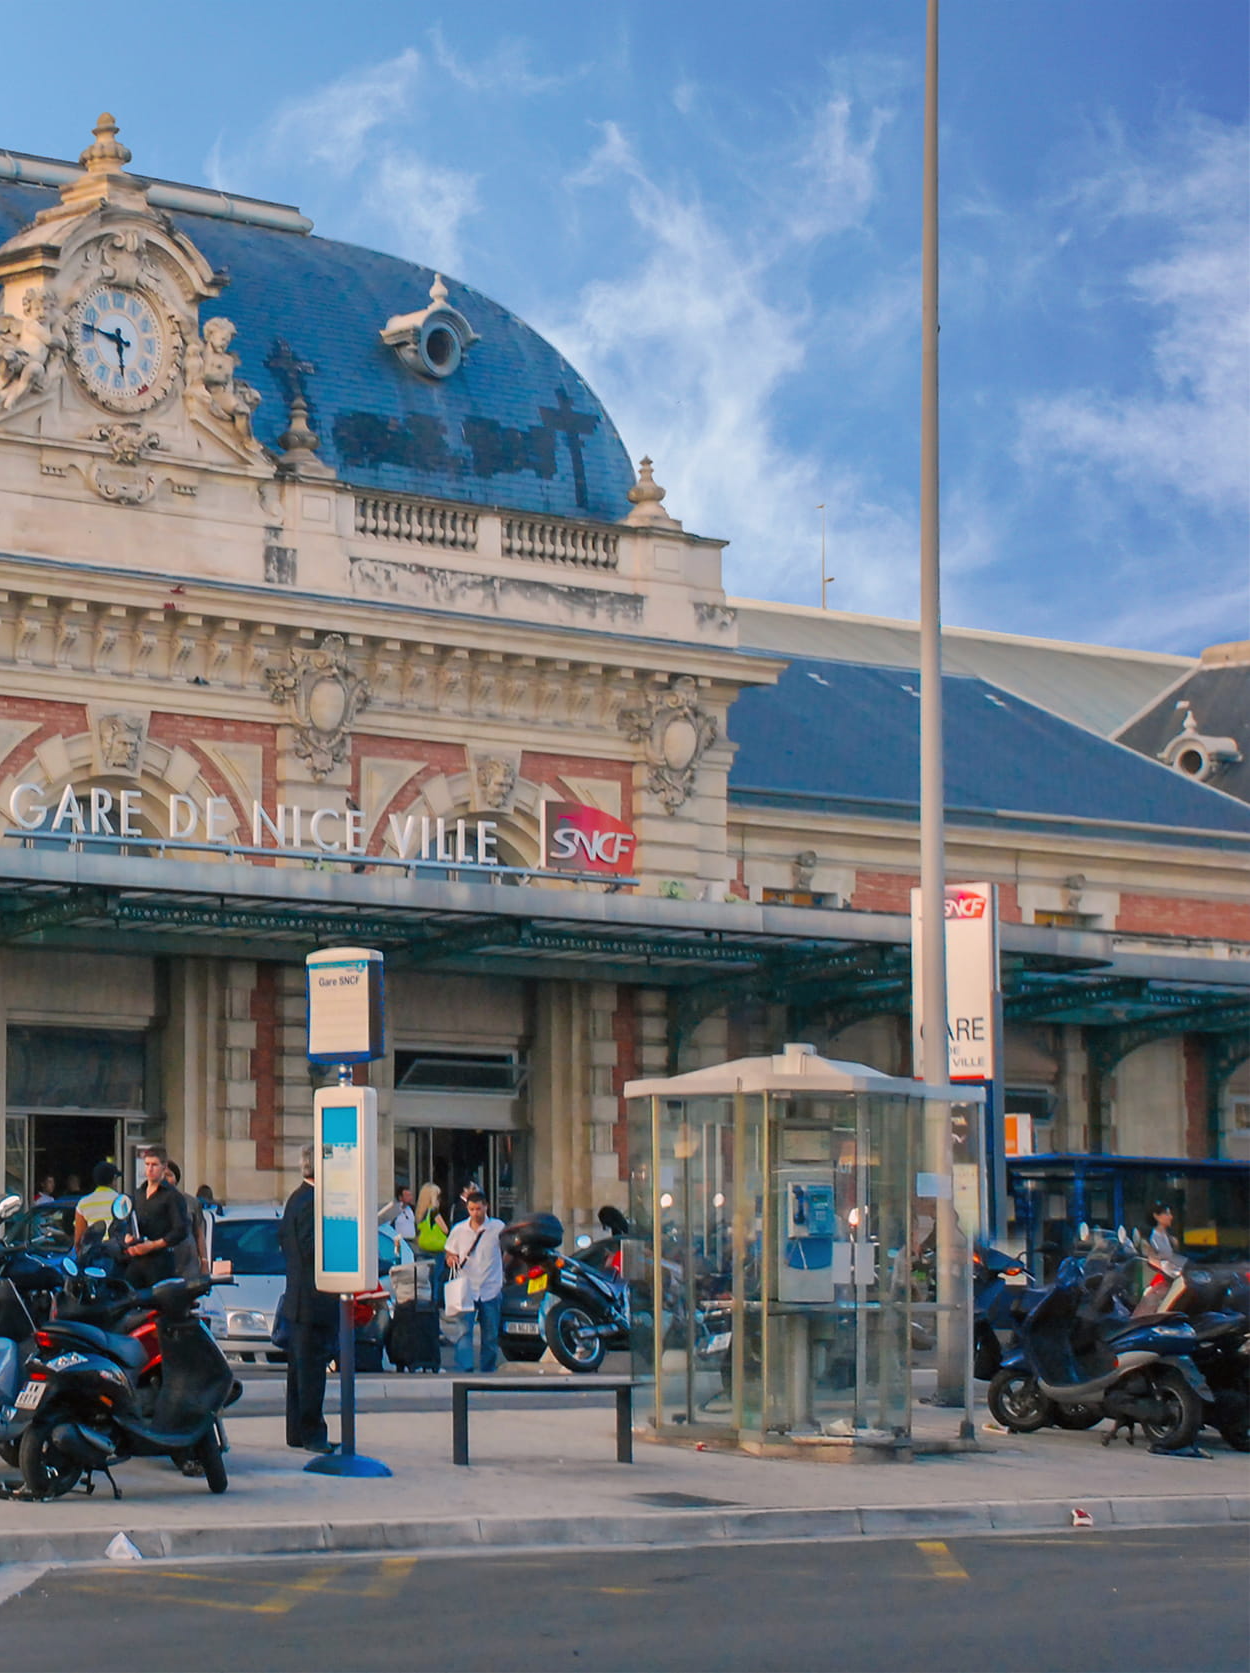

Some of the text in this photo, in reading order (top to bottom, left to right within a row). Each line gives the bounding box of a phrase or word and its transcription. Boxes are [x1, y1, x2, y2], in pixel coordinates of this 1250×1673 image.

[9, 783, 498, 864] GARE DE NICE VILLE
[550, 828, 634, 863] SNCF
[319, 975, 360, 987] Gare SNCF
[953, 1056, 985, 1067] VILLE
